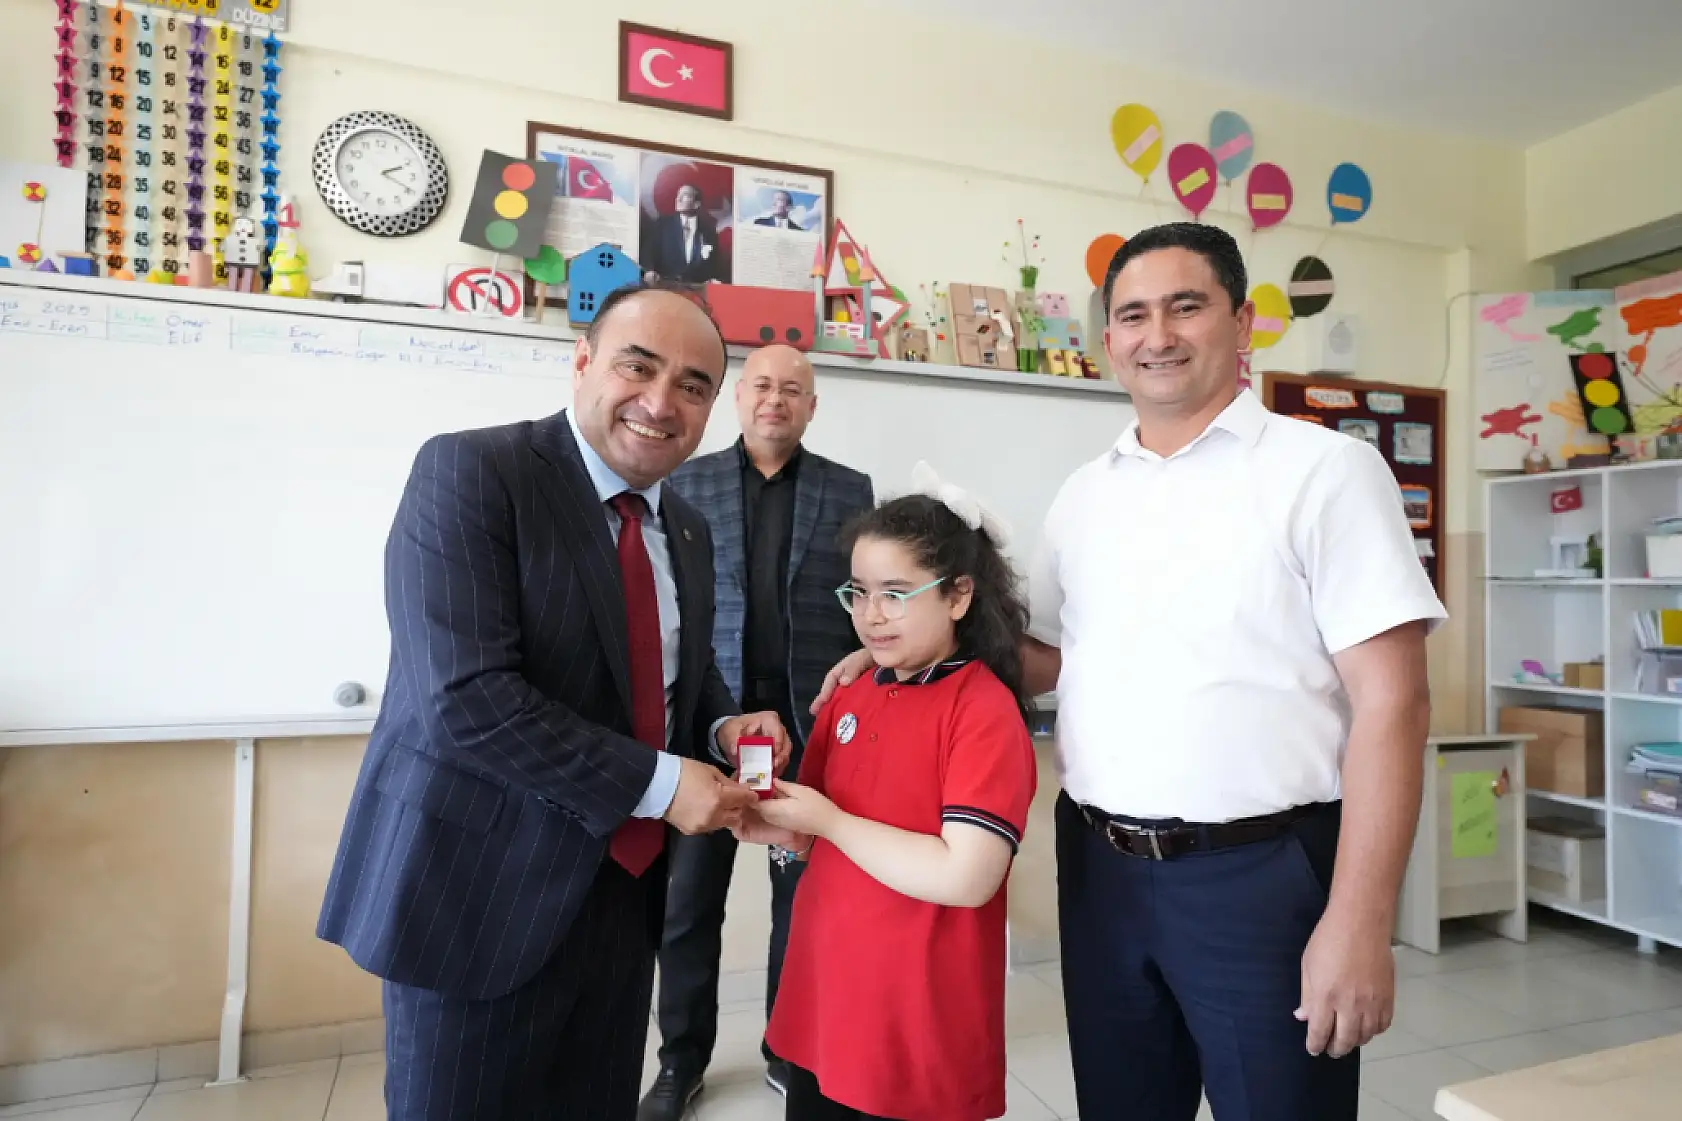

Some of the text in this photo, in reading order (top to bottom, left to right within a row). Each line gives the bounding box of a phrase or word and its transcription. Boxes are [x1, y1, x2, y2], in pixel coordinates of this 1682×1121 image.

[114, 10, 122, 24] 4
[142, 15, 150, 31] 5
[168, 18, 176, 32] 6
[194, 25, 202, 40] 7
[220, 26, 228, 41] 8
[90, 34, 98, 50] 6
[114, 38, 122, 52] 8
[137, 41, 152, 58] 10
[244, 35, 250, 50] 9
[164, 45, 177, 60] 12
[90, 62, 98, 78] 9
[216, 54, 230, 70] 16
[238, 60, 252, 76] 18
[110, 65, 124, 82] 12
[136, 68, 151, 86] 15
[164, 72, 176, 86] 18
[216, 80, 230, 96] 24
[240, 86, 254, 104] 27
[87, 88, 104, 108] 12
[110, 93, 124, 110] 16
[137, 96, 152, 112] 20
[214, 106, 228, 122] 32
[236, 110, 250, 128] 36
[88, 119, 104, 136] 15
[108, 119, 124, 136] 20
[137, 124, 152, 140] 25
[162, 124, 176, 140] 30
[214, 133, 228, 149] 40
[237, 138, 250, 155] 45
[376, 140, 386, 148] 12
[88, 146, 104, 162] 18
[106, 145, 122, 163] 24
[136, 150, 151, 167] 30
[162, 150, 176, 166] 36
[350, 149, 362, 159] 10
[215, 160, 229, 176] 48
[238, 165, 251, 183] 54
[106, 173, 122, 190] 28
[135, 177, 148, 193] 35
[162, 180, 176, 194] 42
[214, 186, 228, 201] 56
[106, 200, 120, 216] 32
[134, 205, 148, 221] 40
[162, 206, 176, 222] 48
[278, 202, 300, 228] 1
[216, 212, 229, 226] 64
[106, 229, 122, 246] 36
[134, 232, 149, 248] 45
[163, 232, 178, 248] 54
[107, 255, 122, 270] 40
[134, 258, 149, 273] 50
[163, 260, 179, 274] 60
